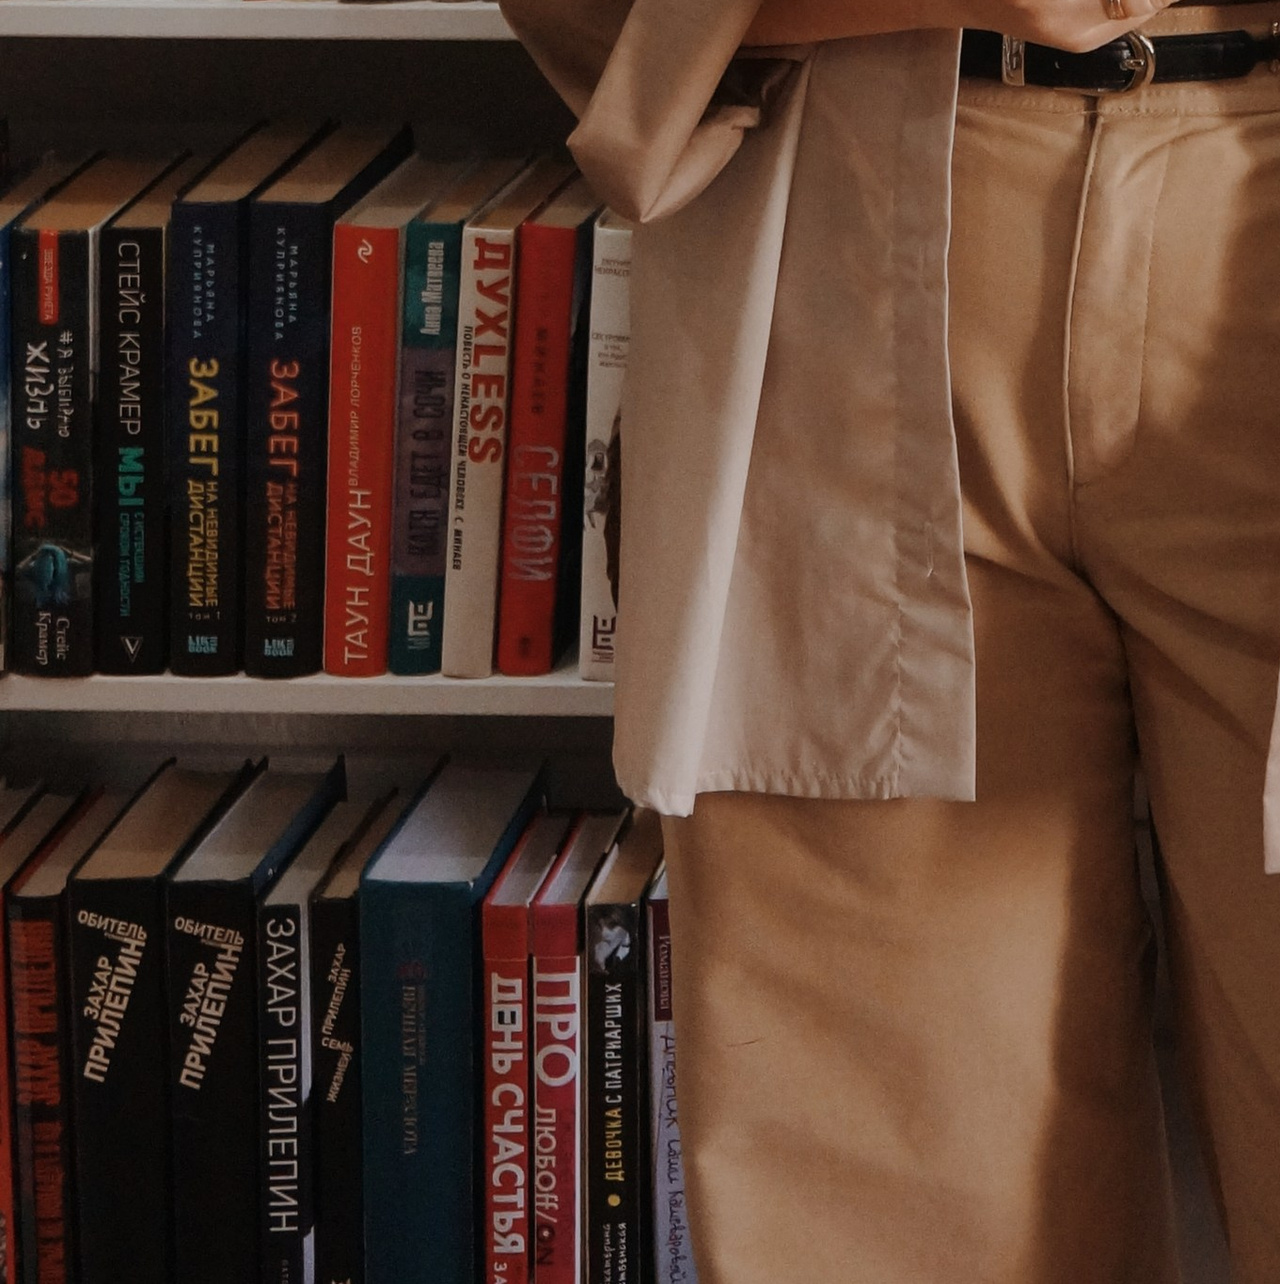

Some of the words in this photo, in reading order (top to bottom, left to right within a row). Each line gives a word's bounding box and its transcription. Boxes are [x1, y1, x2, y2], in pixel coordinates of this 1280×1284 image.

[118, 242, 146, 324] СТЕЙС
[118, 334, 142, 436] КРАМЕР
[349, 326, 363, 407] ЛОРЧЕНКОВ
[469, 237, 511, 464] ДУХLESS
[189, 358, 219, 476] ЗАБЕГ
[347, 411, 360, 486] ВЛАДИМИР
[118, 447, 145, 507] МЫ
[205, 482, 219, 502] НА
[509, 443, 560, 583] СЕЛФИ
[187, 479, 205, 608] ДИСТАНЦИИ
[204, 507, 218, 608] НЕВИДИМЫЕ
[347, 489, 374, 577] ДАУН
[344, 586, 371, 664] ТАУН
[78, 910, 146, 940] ОБИТЕЛЬ
[175, 917, 243, 945] ОБИТЕЛЬ
[83, 935, 146, 1082] ПРИЛЕПИН
[84, 956, 112, 1019] ЗАХАР
[180, 963, 209, 1026] ЗАХАР
[268, 918, 295, 1026] ЗАХАР
[322, 967, 351, 1035] ПРИЛЕПИН
[179, 941, 242, 1089] ПРИЛЕПИН
[603, 984, 621, 1089] ПАТРИАРШИХ
[268, 1039, 298, 1232] ПРИЛЕПИН
[606, 1094, 623, 1103] С
[606, 1105, 625, 1182] ДЕВОЧКА
